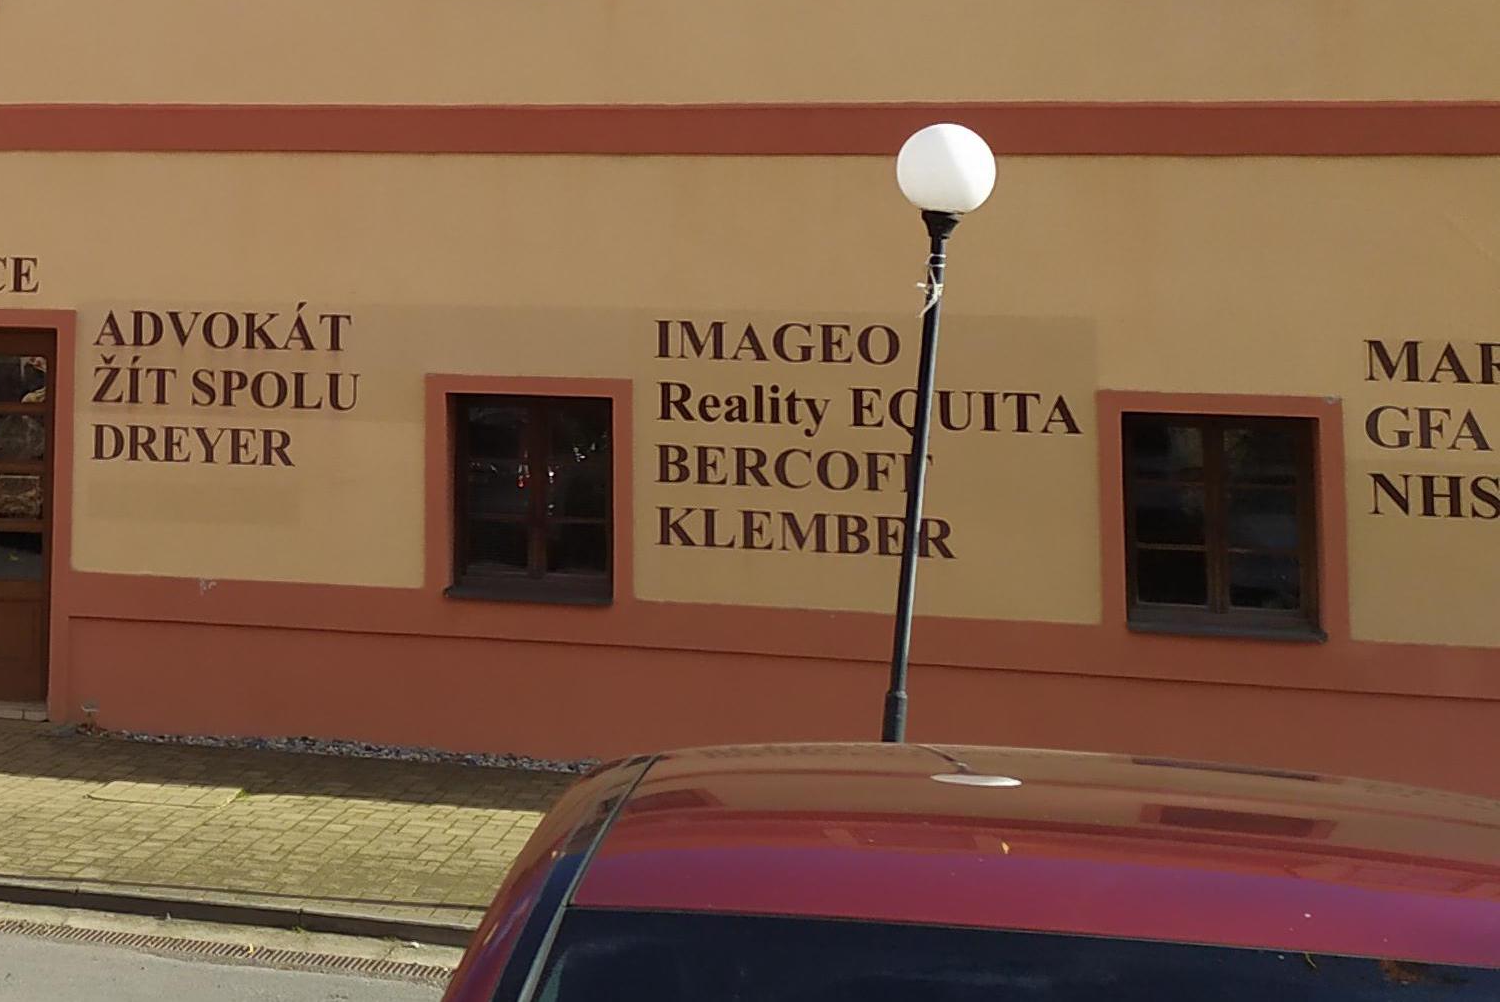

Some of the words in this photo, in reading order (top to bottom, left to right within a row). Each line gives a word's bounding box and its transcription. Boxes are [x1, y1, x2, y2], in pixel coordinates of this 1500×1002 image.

[93, 301, 352, 352] ADVOKÁT
[654, 319, 901, 365] IMAGEO
[91, 353, 176, 407] ŽÍT
[191, 368, 360, 411] SPOLU
[656, 382, 832, 436] Reality
[849, 387, 1083, 438] EQUITA
[1365, 405, 1493, 451] GFA
[91, 423, 294, 466] DREYER
[655, 506, 957, 560] KLEMBER
